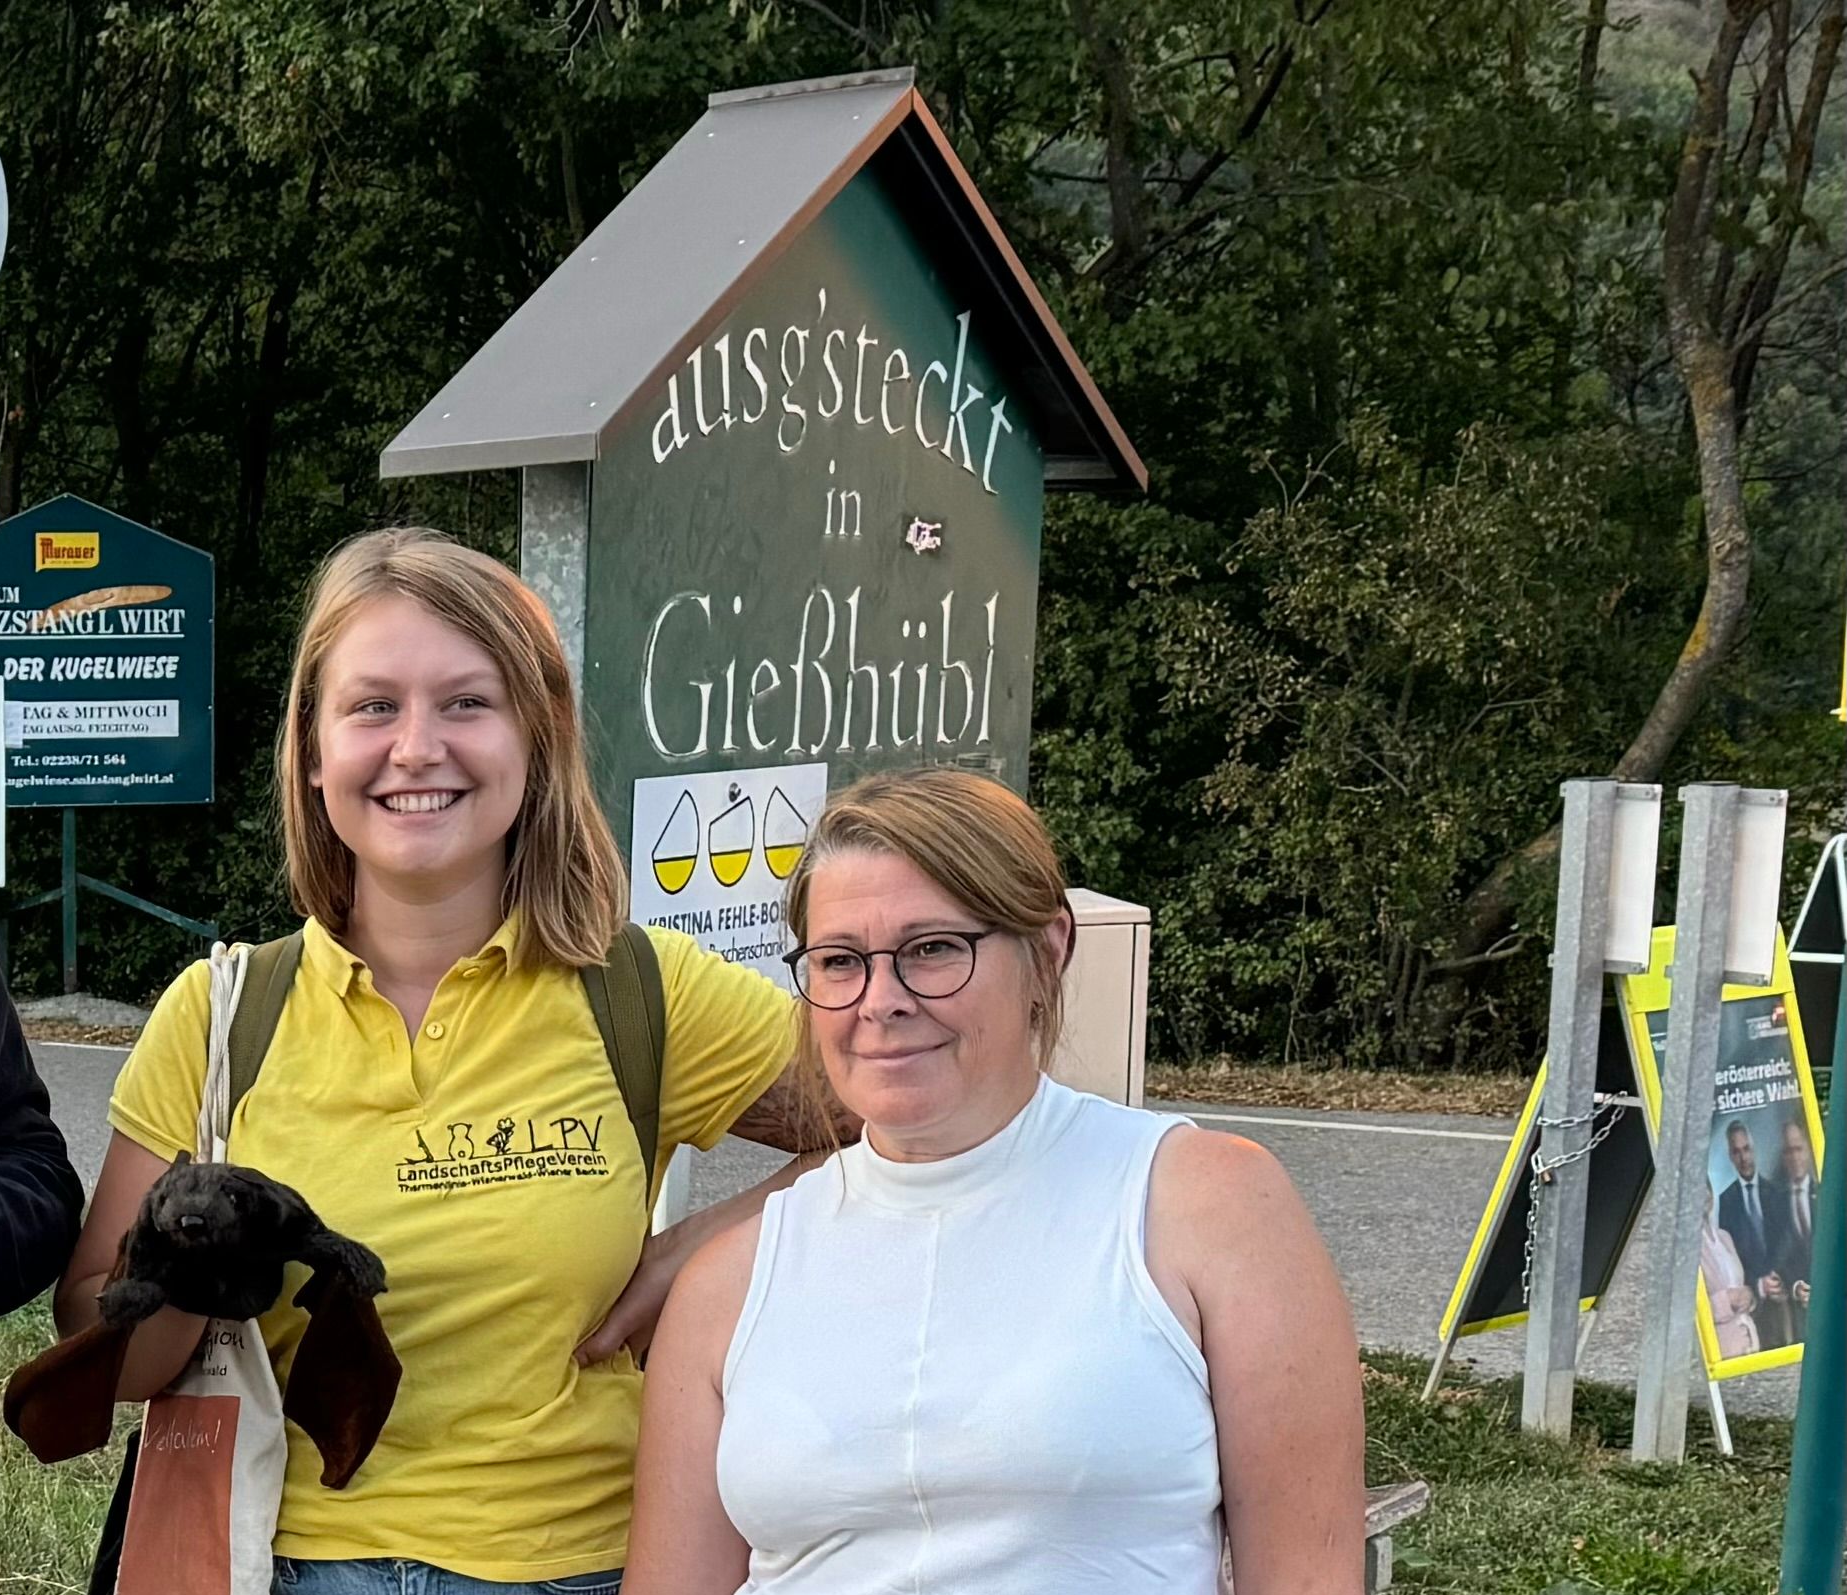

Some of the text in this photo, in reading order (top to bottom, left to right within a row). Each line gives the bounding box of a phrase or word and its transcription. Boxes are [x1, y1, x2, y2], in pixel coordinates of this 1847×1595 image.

[653, 287, 1013, 495] ausg'steckt
[823, 459, 862, 537] in
[119, 609, 186, 634] WIRT
[4, 657, 45, 681] DER
[50, 656, 180, 681] KUGELWIESE
[642, 585, 999, 760] Gießhübl
[57, 707, 69, 718] &
[75, 704, 167, 719] MITTWOCH
[527, 1115, 604, 1153] LPV
[397, 1151, 608, 1182] LandschaftsPflegeVerein
